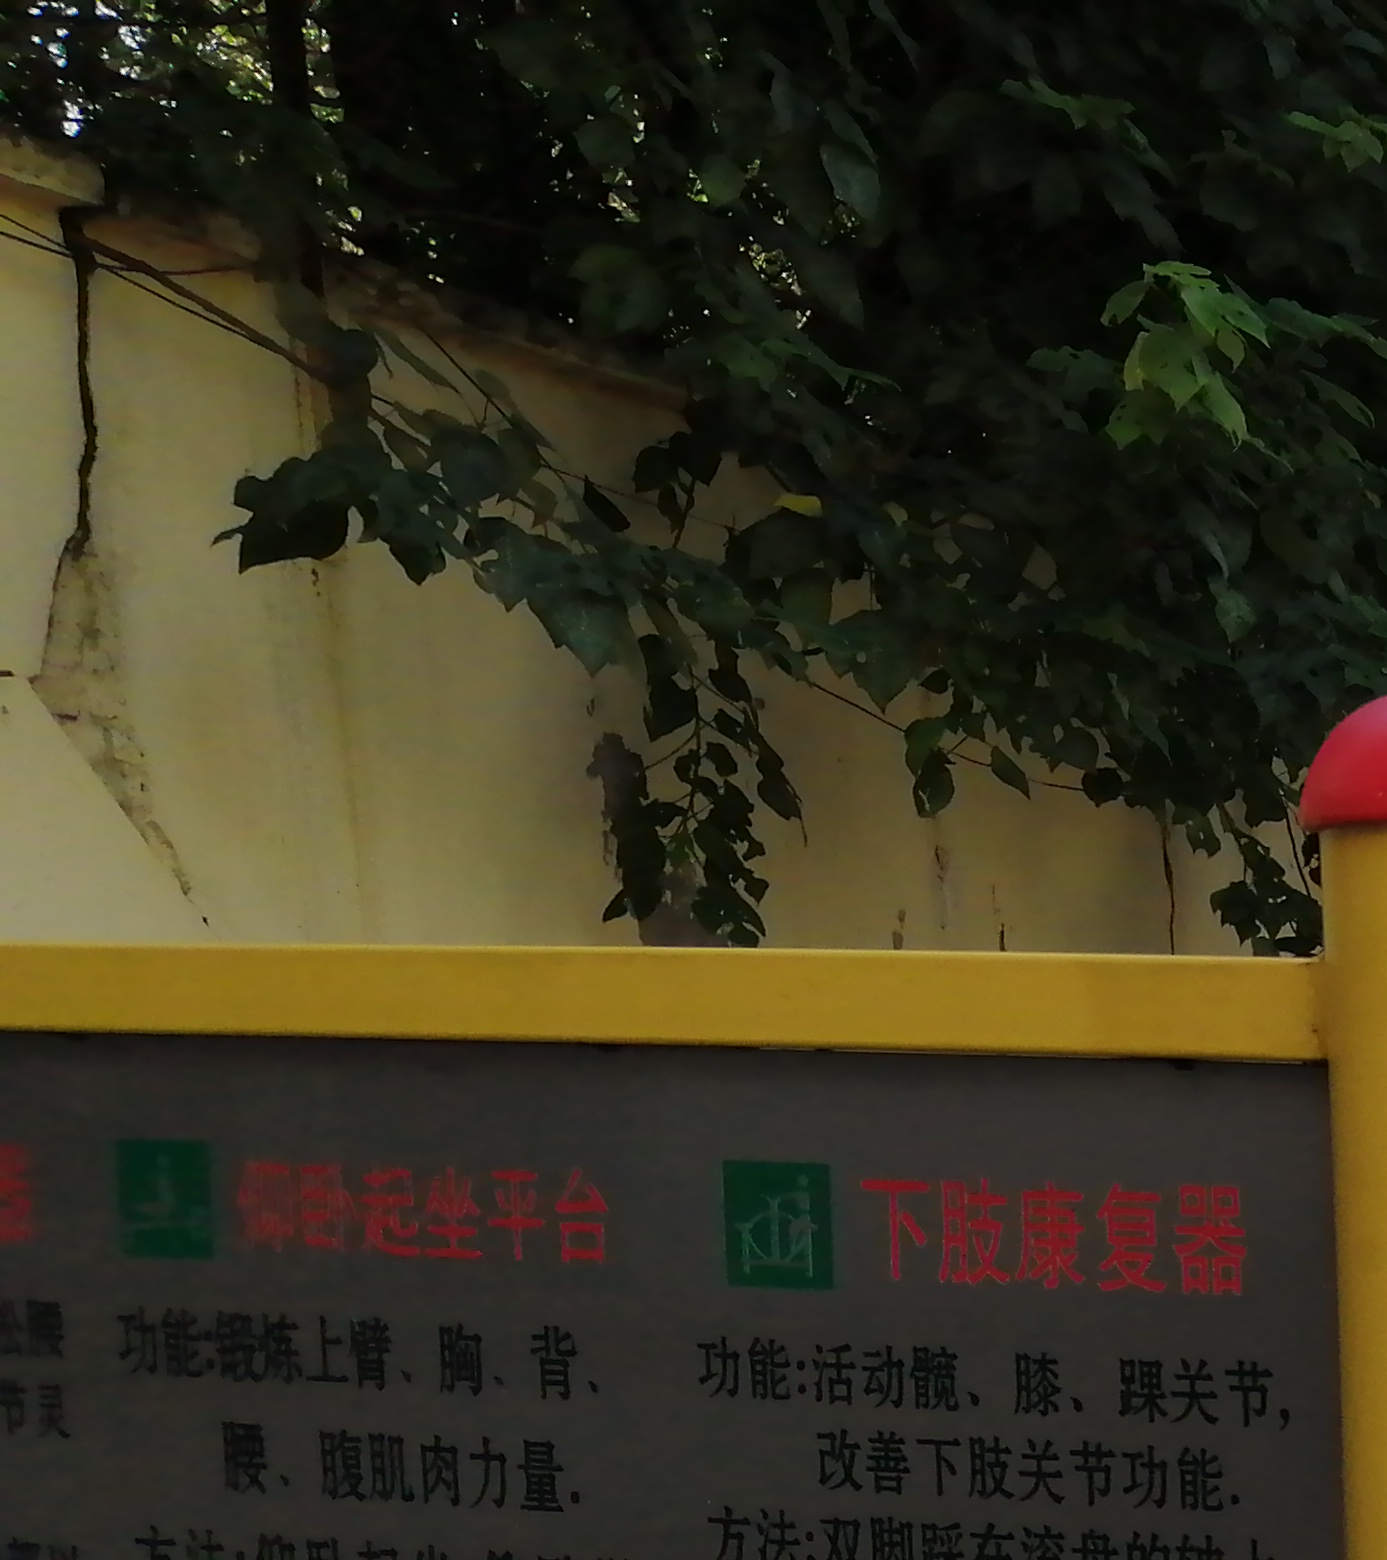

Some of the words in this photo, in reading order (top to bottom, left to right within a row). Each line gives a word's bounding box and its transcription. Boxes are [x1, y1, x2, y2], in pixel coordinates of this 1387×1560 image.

[860, 1177, 1248, 1296] 下肢康复器
